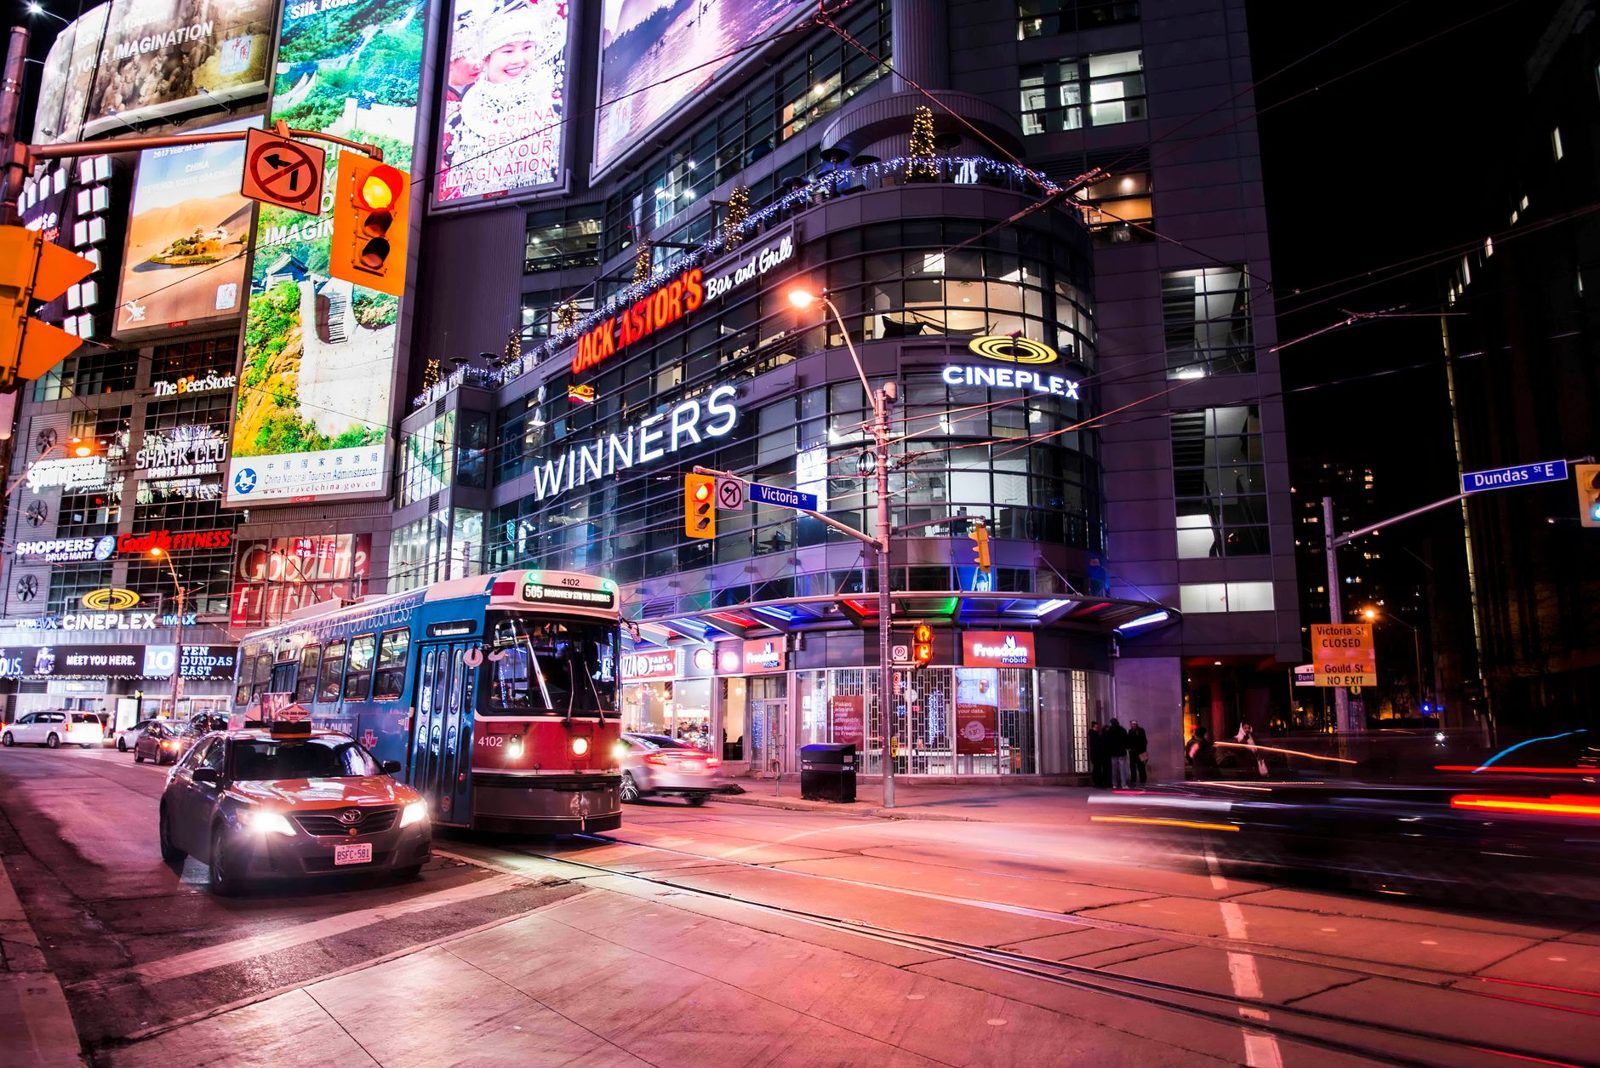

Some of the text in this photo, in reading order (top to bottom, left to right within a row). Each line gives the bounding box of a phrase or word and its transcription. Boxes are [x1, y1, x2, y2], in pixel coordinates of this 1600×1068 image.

[290, 1, 318, 20] Silk
[112, 21, 214, 61] IMAGINATION
[506, 106, 555, 128] CHINA
[487, 123, 553, 147] BEYOND
[508, 140, 552, 159] YOUR
[447, 157, 551, 185] IMAGINATION
[704, 235, 794, 301] Bar and Grill
[571, 266, 704, 375] JACK ASTOR'S
[942, 365, 1080, 400] CINEPLEX
[533, 384, 738, 502] WINNERS
[135, 443, 191, 469] SHARK
[197, 462, 218, 475] GRILL
[264, 473, 282, 485] China
[308, 470, 332, 482] Tourism
[332, 467, 378, 481] Administration
[1474, 464, 1555, 487] Dundas St E
[761, 486, 808, 505] Victoria St
[16, 538, 95, 556] SHOPPERS
[173, 530, 232, 549] FITNESS
[45, 550, 94, 563] DRUG MART
[240, 537, 366, 582] GoodLife
[561, 578, 580, 587] 4102
[525, 585, 544, 599] 505
[62, 613, 157, 630] CINEPLEX
[1316, 626, 1352, 635] Victoria
[182, 646, 210, 656] TEN
[973, 642, 1028, 658] Freedom
[1322, 638, 1361, 648] CLOSED
[66, 654, 137, 667] MEET YOU HERE.
[147, 651, 175, 671] 10
[181, 656, 234, 667] DUNDAS
[746, 652, 779, 664] Freedom
[1002, 656, 1027, 664] mobile
[180, 666, 213, 676] EAST
[1324, 664, 1364, 673] Gould St
[1327, 676, 1363, 685] NO EXIT
[478, 736, 503, 747] 4102
